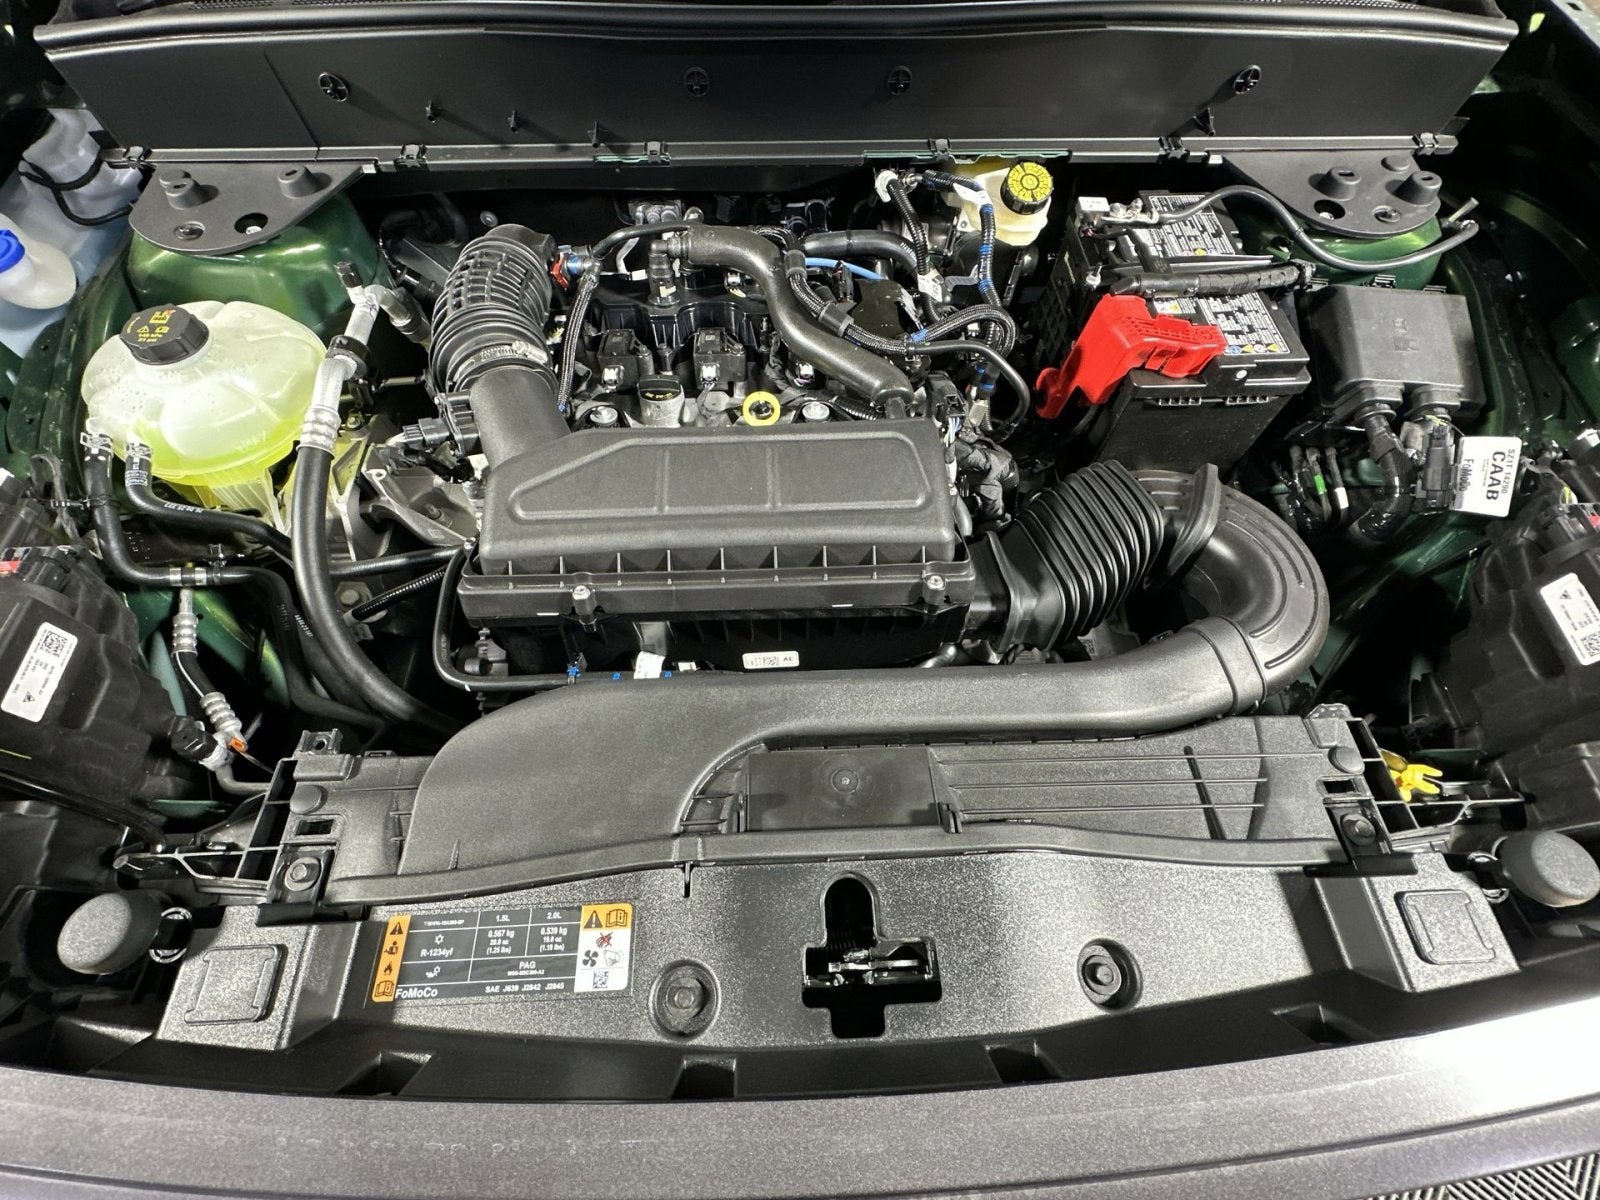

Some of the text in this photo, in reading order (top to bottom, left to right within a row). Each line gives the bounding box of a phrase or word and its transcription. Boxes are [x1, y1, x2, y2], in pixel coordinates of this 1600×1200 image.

[1458, 458, 1474, 492] FoMoCo
[1486, 451, 1506, 500] CAAB
[1501, 472, 1513, 494] 14290
[496, 914, 510, 922] 1.5L
[488, 929, 515, 938] 0.567 kg
[540, 926, 567, 935] 0.539 kg
[420, 947, 454, 957] R-1234yf
[519, 961, 536, 969] PAG
[395, 986, 438, 999] FoMoCo
[485, 982, 565, 993] SAE J639 J2842 J2845
